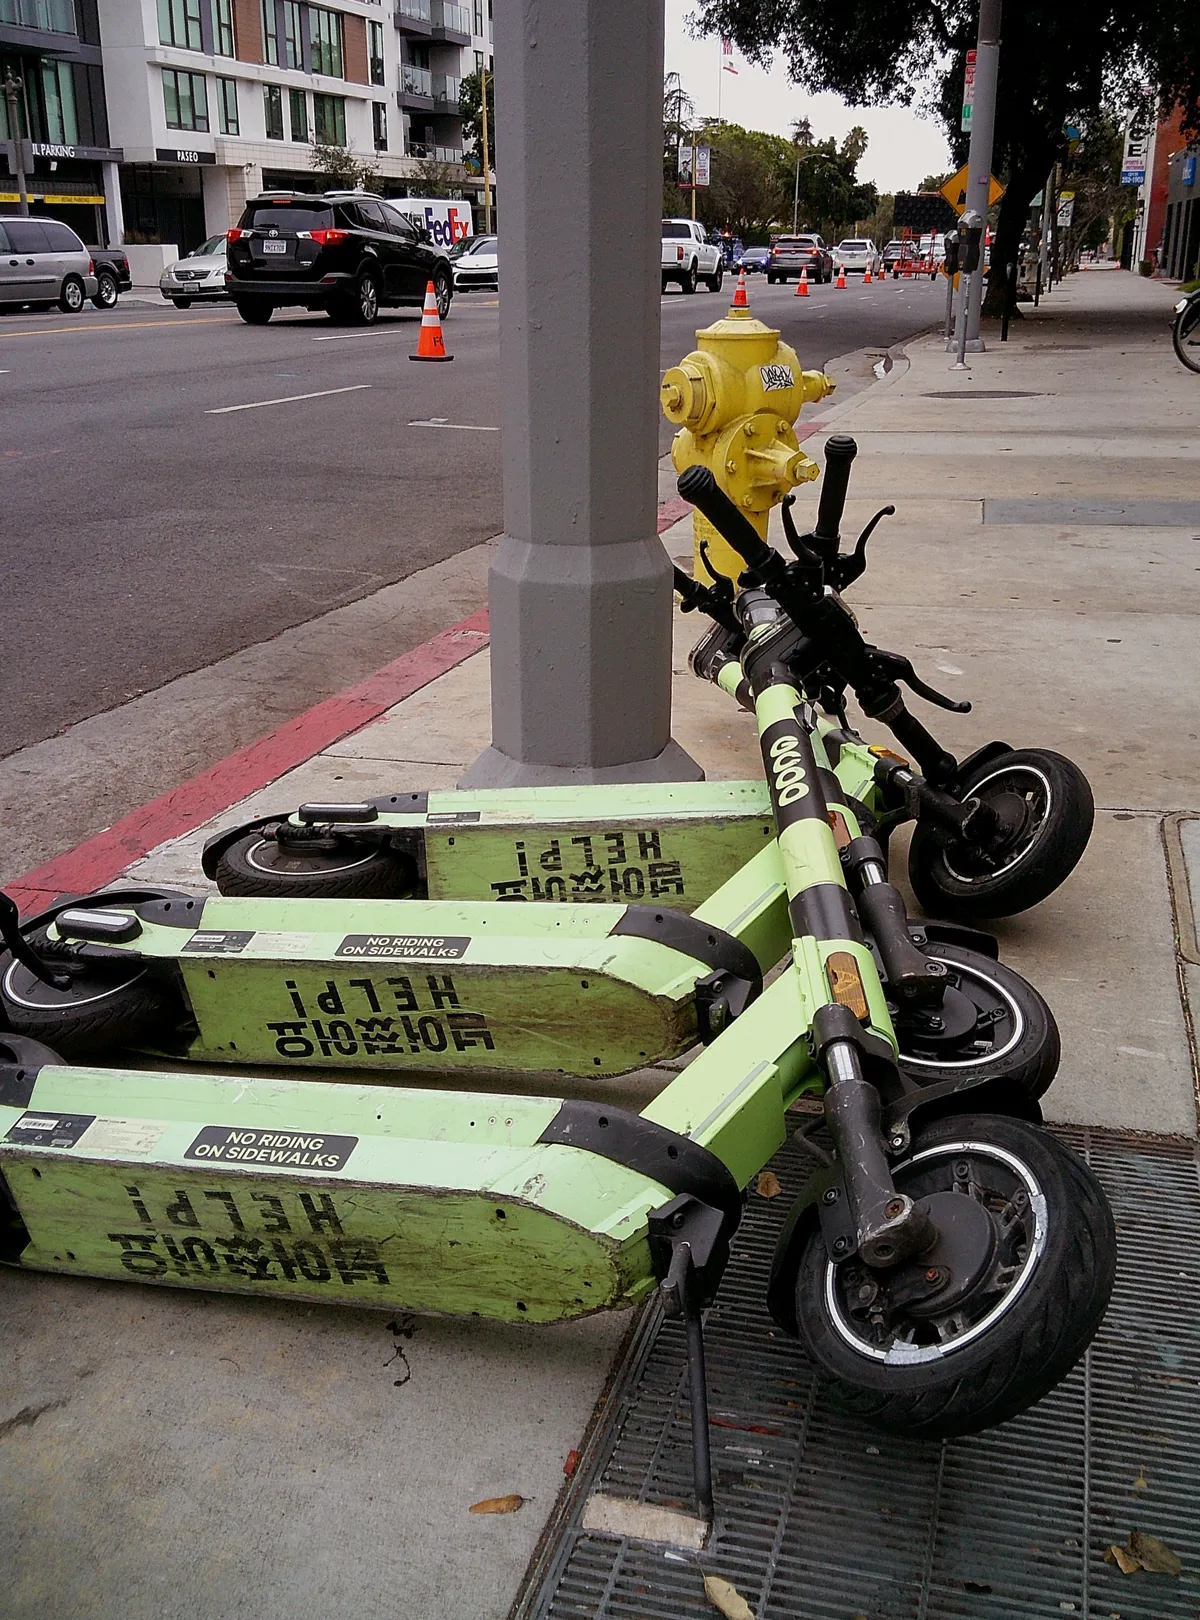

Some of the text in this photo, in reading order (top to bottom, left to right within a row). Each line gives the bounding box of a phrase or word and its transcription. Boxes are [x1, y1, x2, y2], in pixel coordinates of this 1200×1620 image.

[41, 144, 75, 158] PARKING
[176, 150, 199, 162] PASEO
[424, 207, 469, 247] FedEx
[515, 831, 662, 876] HELP!
[342, 946, 459, 957] ON SIDEWALKS
[366, 937, 445, 947] NO RIDING
[285, 975, 461, 1018] HELP!
[266, 1013, 496, 1059] 넘어졌어요
[226, 1131, 325, 1150] NO RIDING
[194, 1144, 340, 1167] ON SIDEWALKS
[124, 1185, 343, 1236] HELP!
